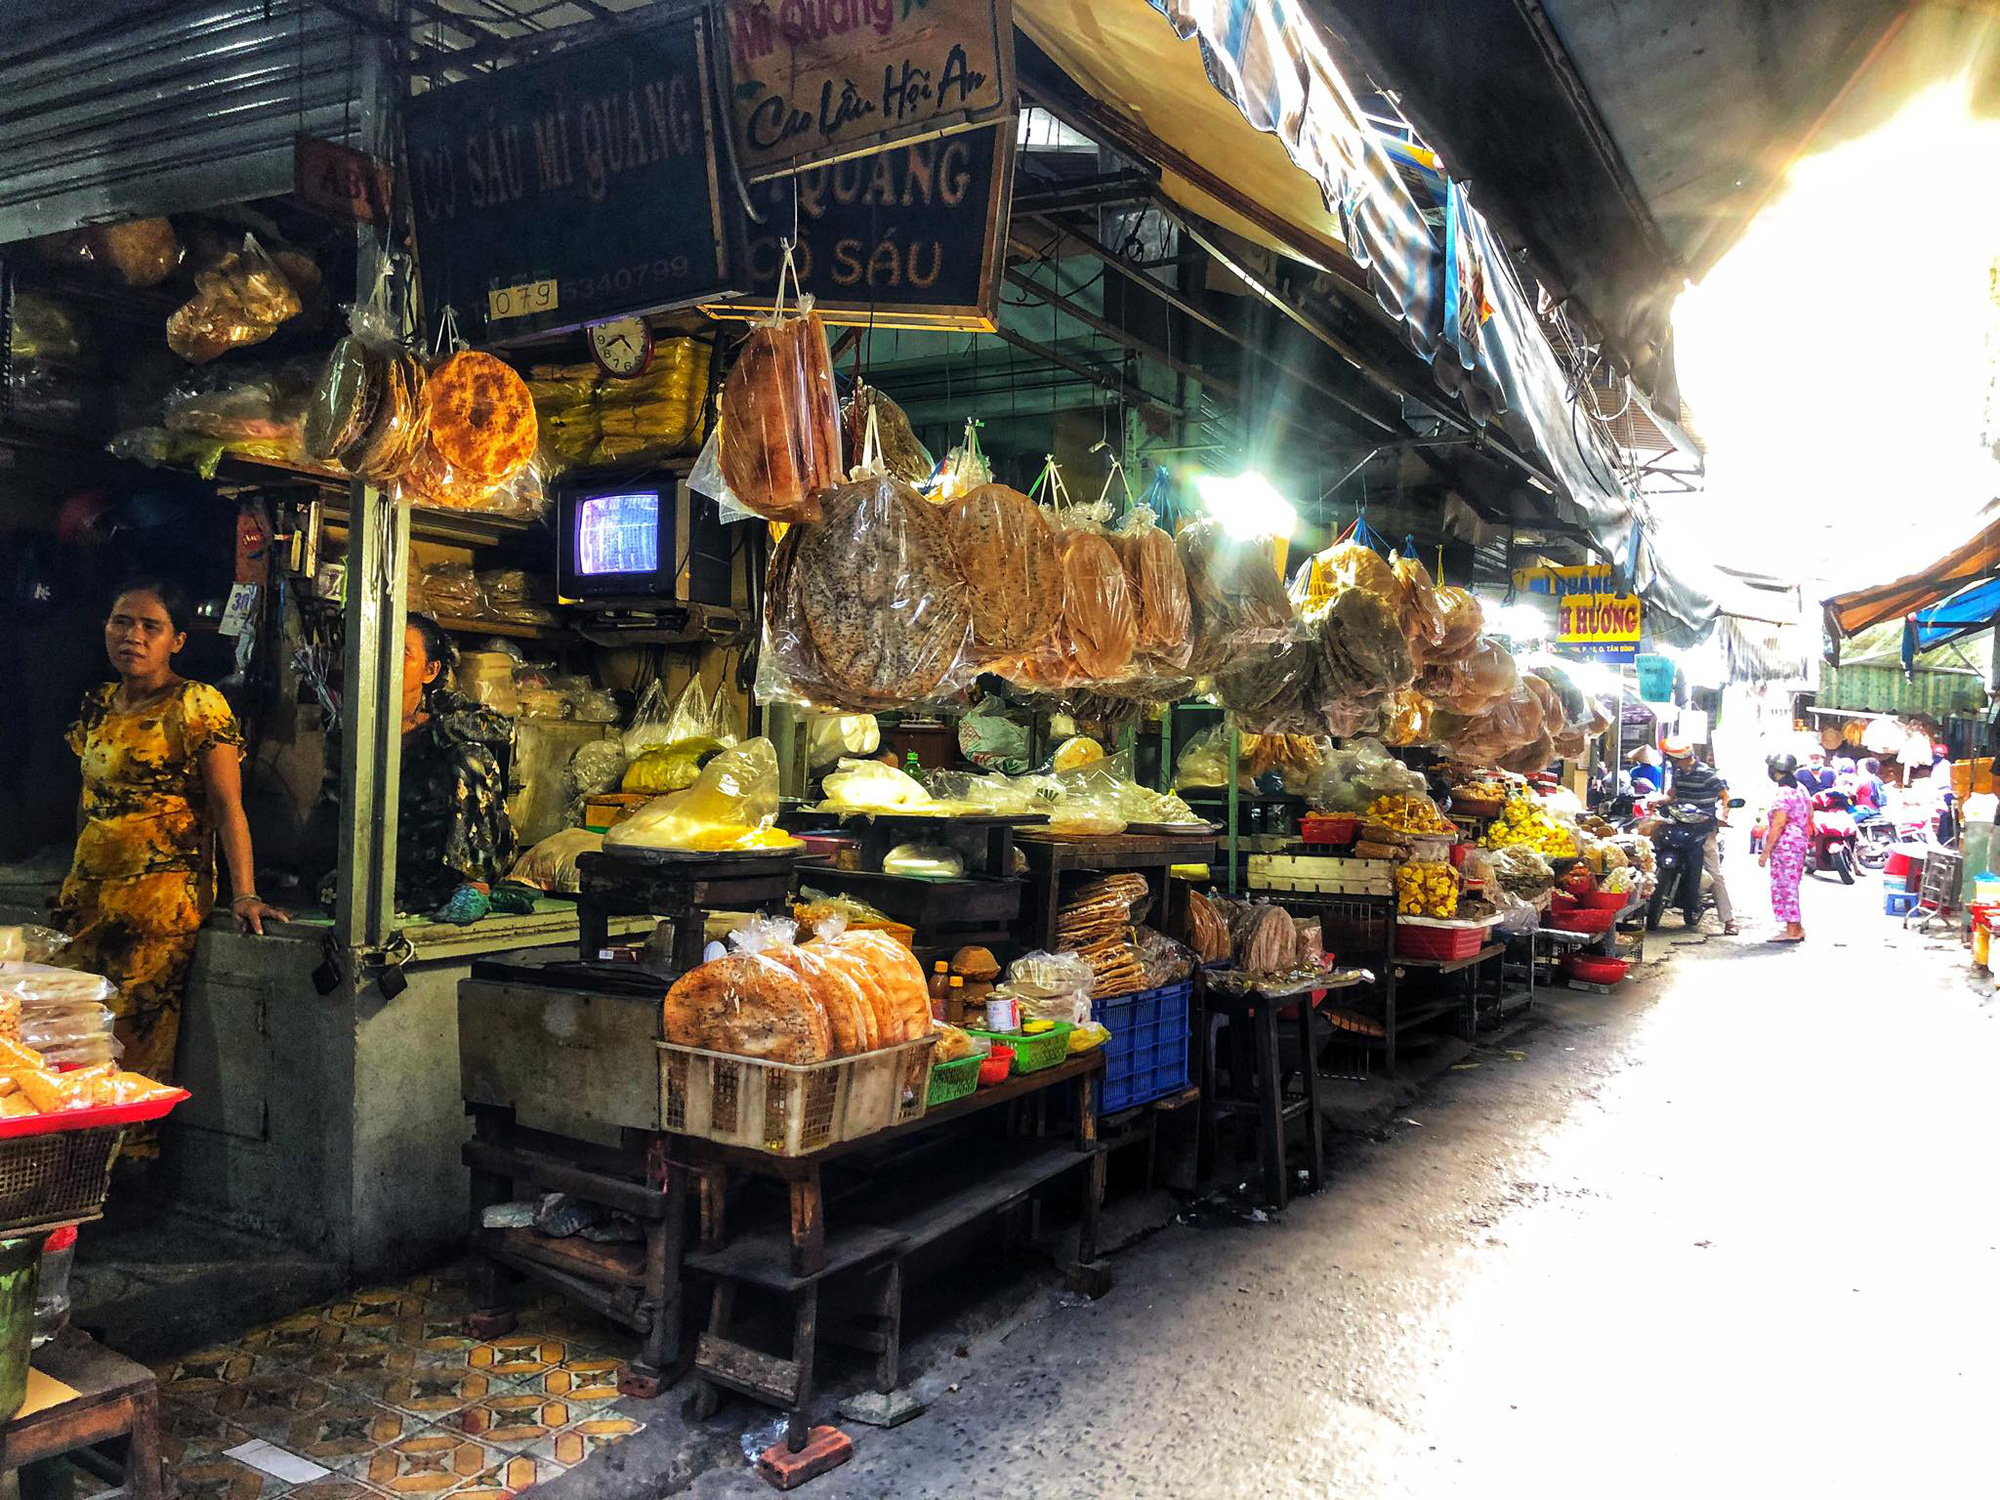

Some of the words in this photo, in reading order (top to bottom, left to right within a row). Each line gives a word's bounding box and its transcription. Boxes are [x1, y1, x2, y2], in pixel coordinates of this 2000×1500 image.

[883, 59, 934, 119] Hội
[936, 43, 987, 109] An
[831, 226, 943, 289] SÁU
[495, 282, 551, 315] 079
[1576, 602, 1639, 635] HƯƠNG
